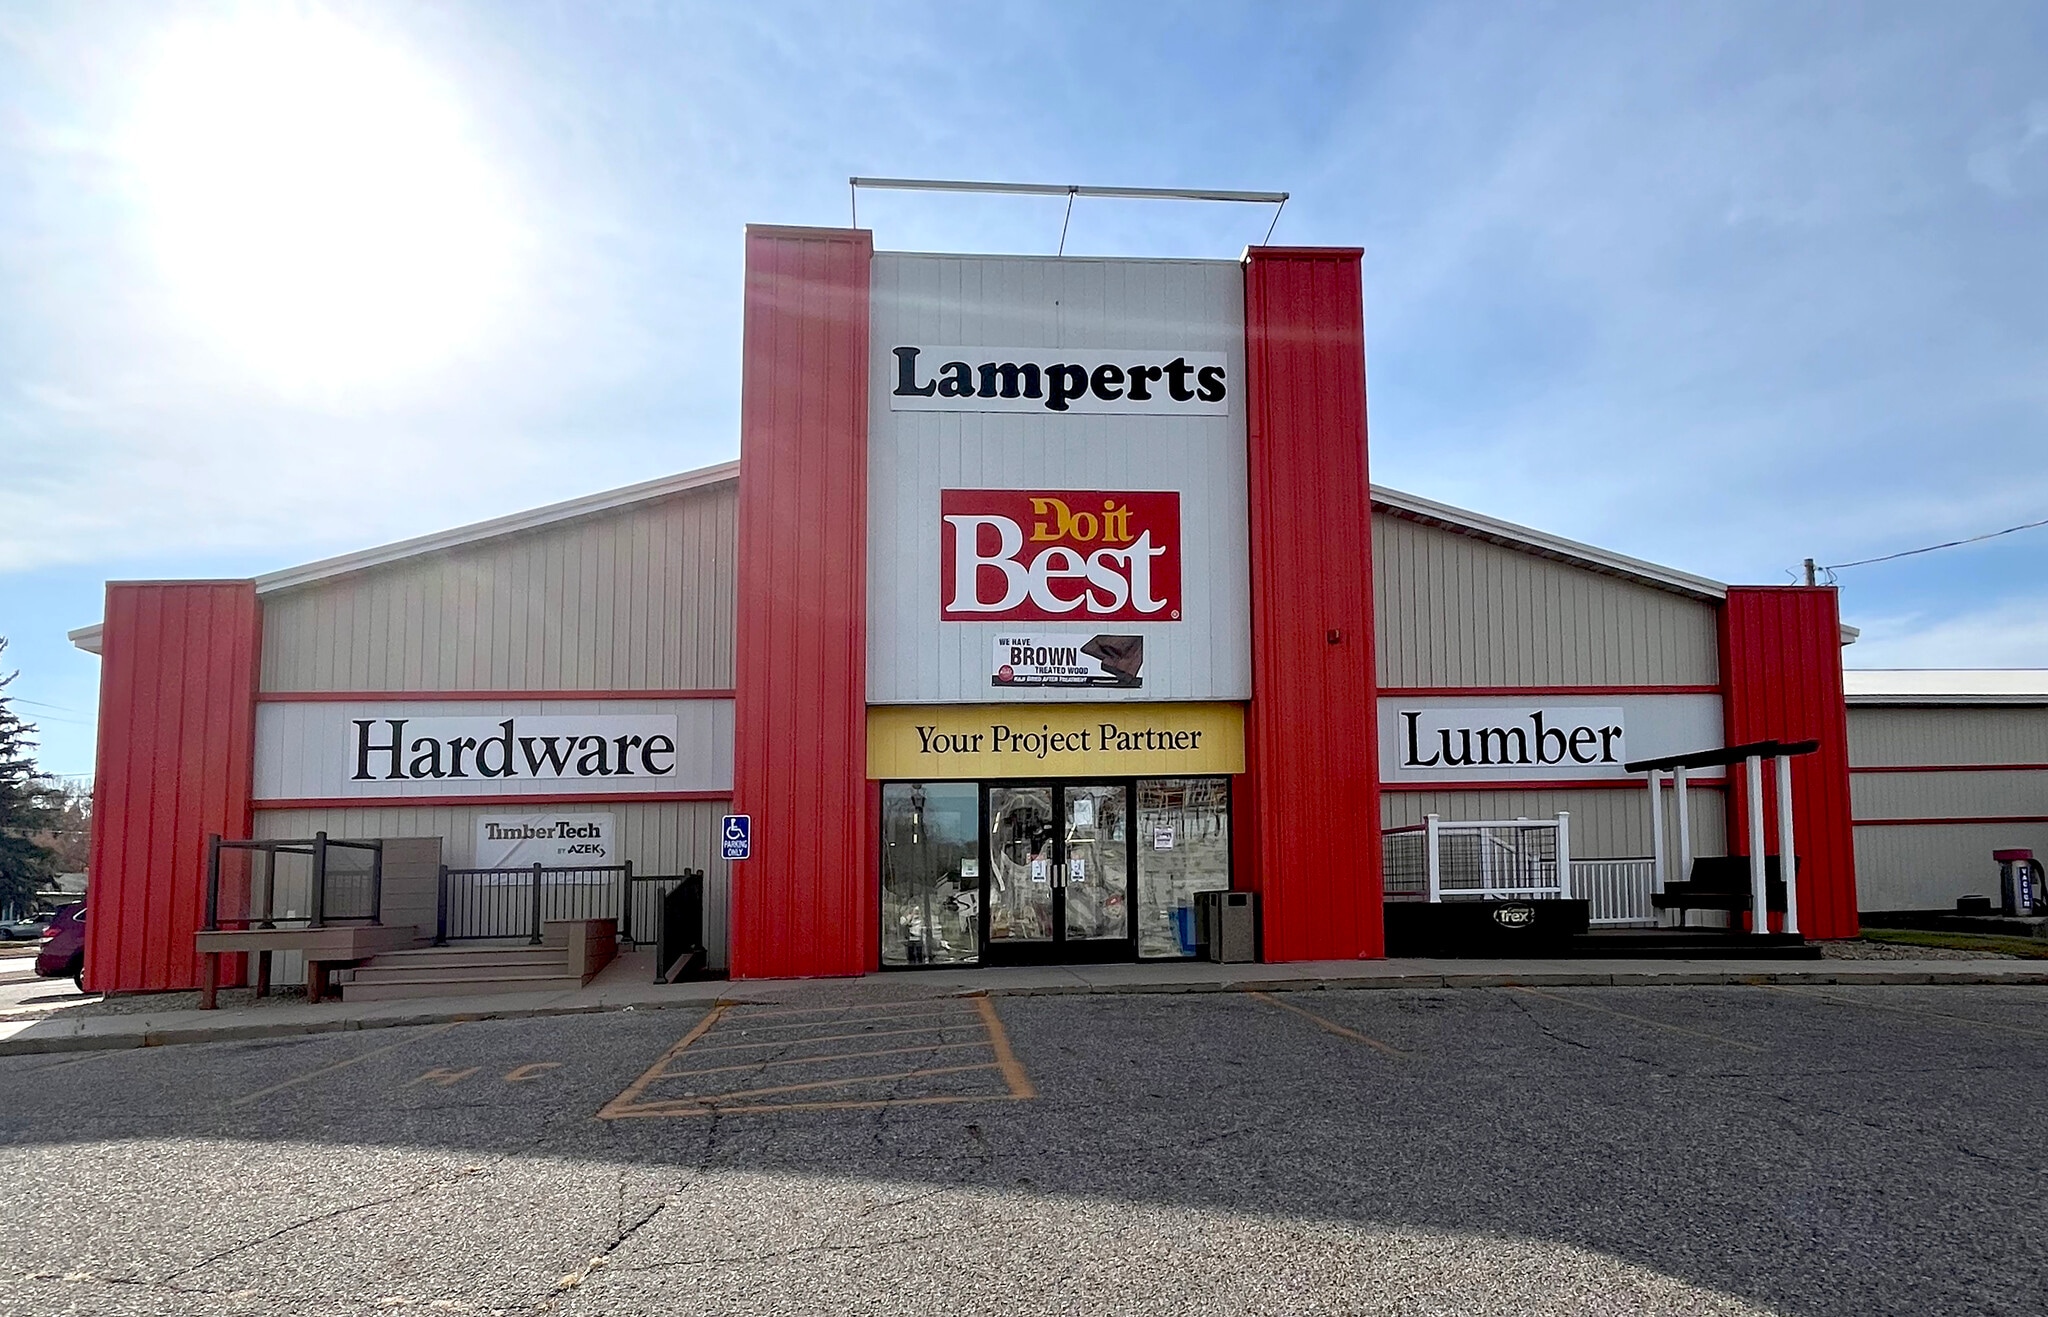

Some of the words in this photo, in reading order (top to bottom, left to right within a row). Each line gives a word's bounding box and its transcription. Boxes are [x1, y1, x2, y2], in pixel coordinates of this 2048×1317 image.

[892, 346, 1227, 411] Lamperts
[1029, 498, 1098, 541] Do
[1101, 500, 1134, 541] it
[943, 515, 1168, 614] Best
[999, 638, 1010, 646] WE
[1012, 638, 1031, 646] HAVE
[1010, 646, 1077, 666] BROWN
[1035, 666, 1066, 674] TREATED
[1068, 667, 1089, 675] WOOD
[915, 726, 983, 753] Your
[990, 724, 1091, 759] Project
[1098, 723, 1202, 751] Partner
[1401, 710, 1623, 766] Lumber
[351, 718, 676, 780] Hardware
[485, 822, 601, 840] TimberTech
[568, 844, 601, 854] AZEK
[724, 840, 747, 849] PARKING
[727, 849, 744, 857] ONLY
[2021, 868, 2030, 907] VACUUM
[1498, 910, 1529, 922] Trex
